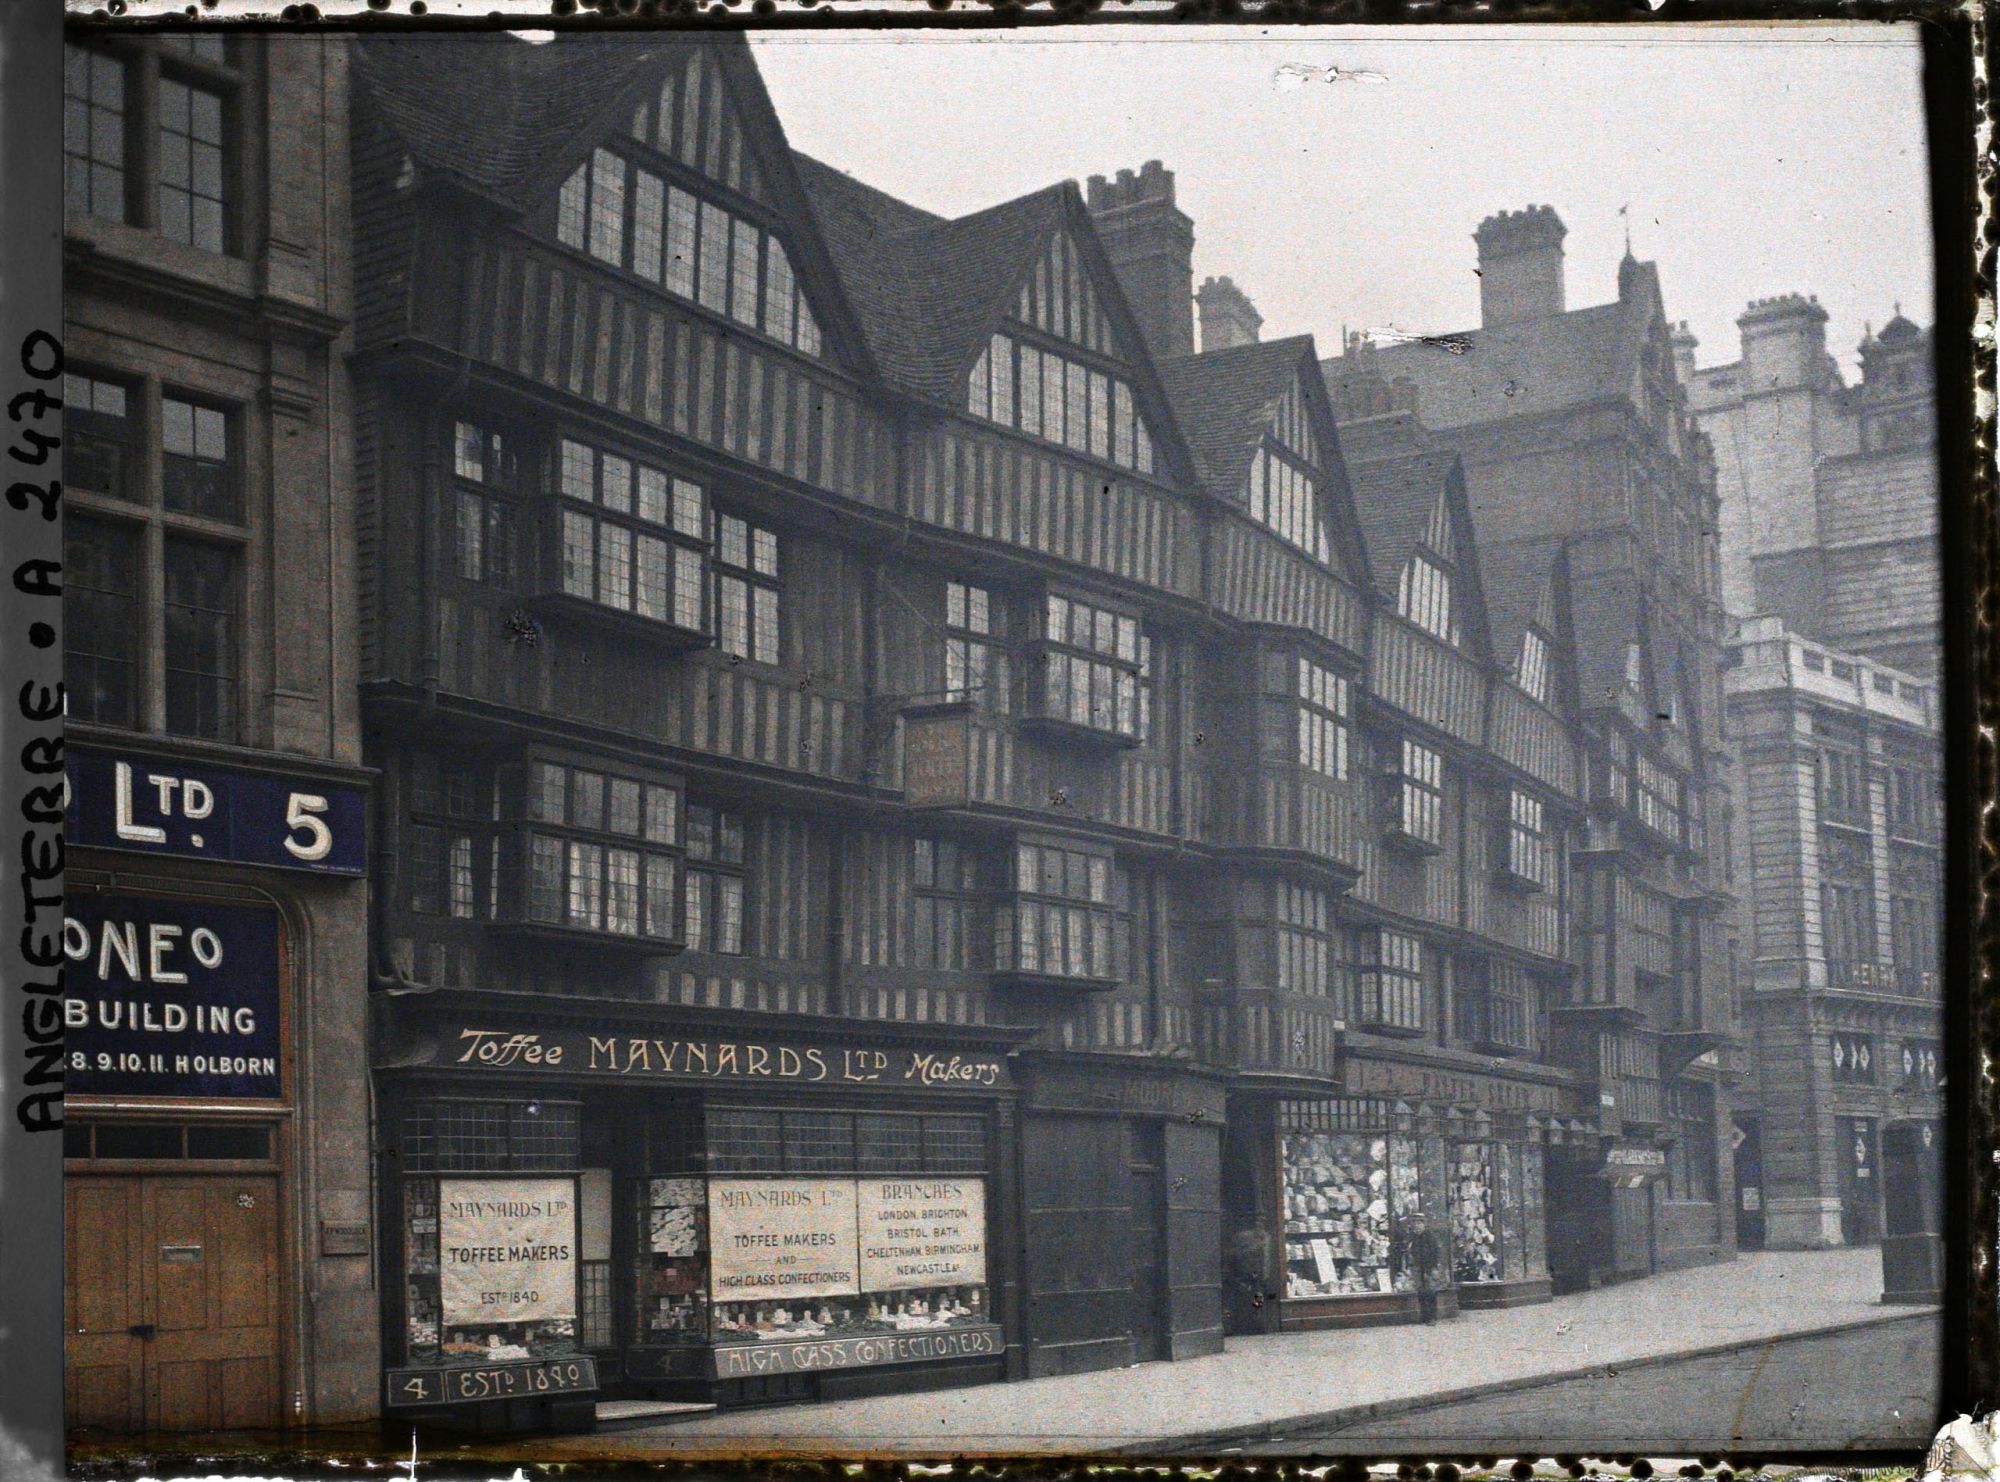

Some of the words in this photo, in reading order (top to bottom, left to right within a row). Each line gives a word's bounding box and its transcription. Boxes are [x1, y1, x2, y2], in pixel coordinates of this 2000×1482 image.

[283, 791, 333, 861] 5
[64, 998, 256, 1035] BUILDING
[175, 1054, 275, 1077] HOLBORN
[456, 1028, 563, 1067] Toffee
[588, 1036, 828, 1081] MAYNARDS
[904, 1052, 999, 1085] Makers
[719, 1189, 812, 1208] MAYNARDS
[449, 1201, 542, 1218] MAYNARDS
[734, 1234, 779, 1248] TOFFEE
[783, 1232, 837, 1246] MAKERS
[450, 1247, 505, 1264] TOFFEE
[508, 1245, 569, 1262] MAKERS
[775, 1255, 797, 1265] AND
[718, 1275, 743, 1288] HIGH
[743, 1274, 776, 1287] CLASS
[778, 1271, 851, 1285] CONFECTIONERS
[508, 1290, 539, 1304] 1840
[728, 1350, 783, 1374] HIGH
[792, 1343, 848, 1370] CLASS
[856, 1330, 994, 1364] CONFECTIONERS
[403, 1377, 429, 1400] 4
